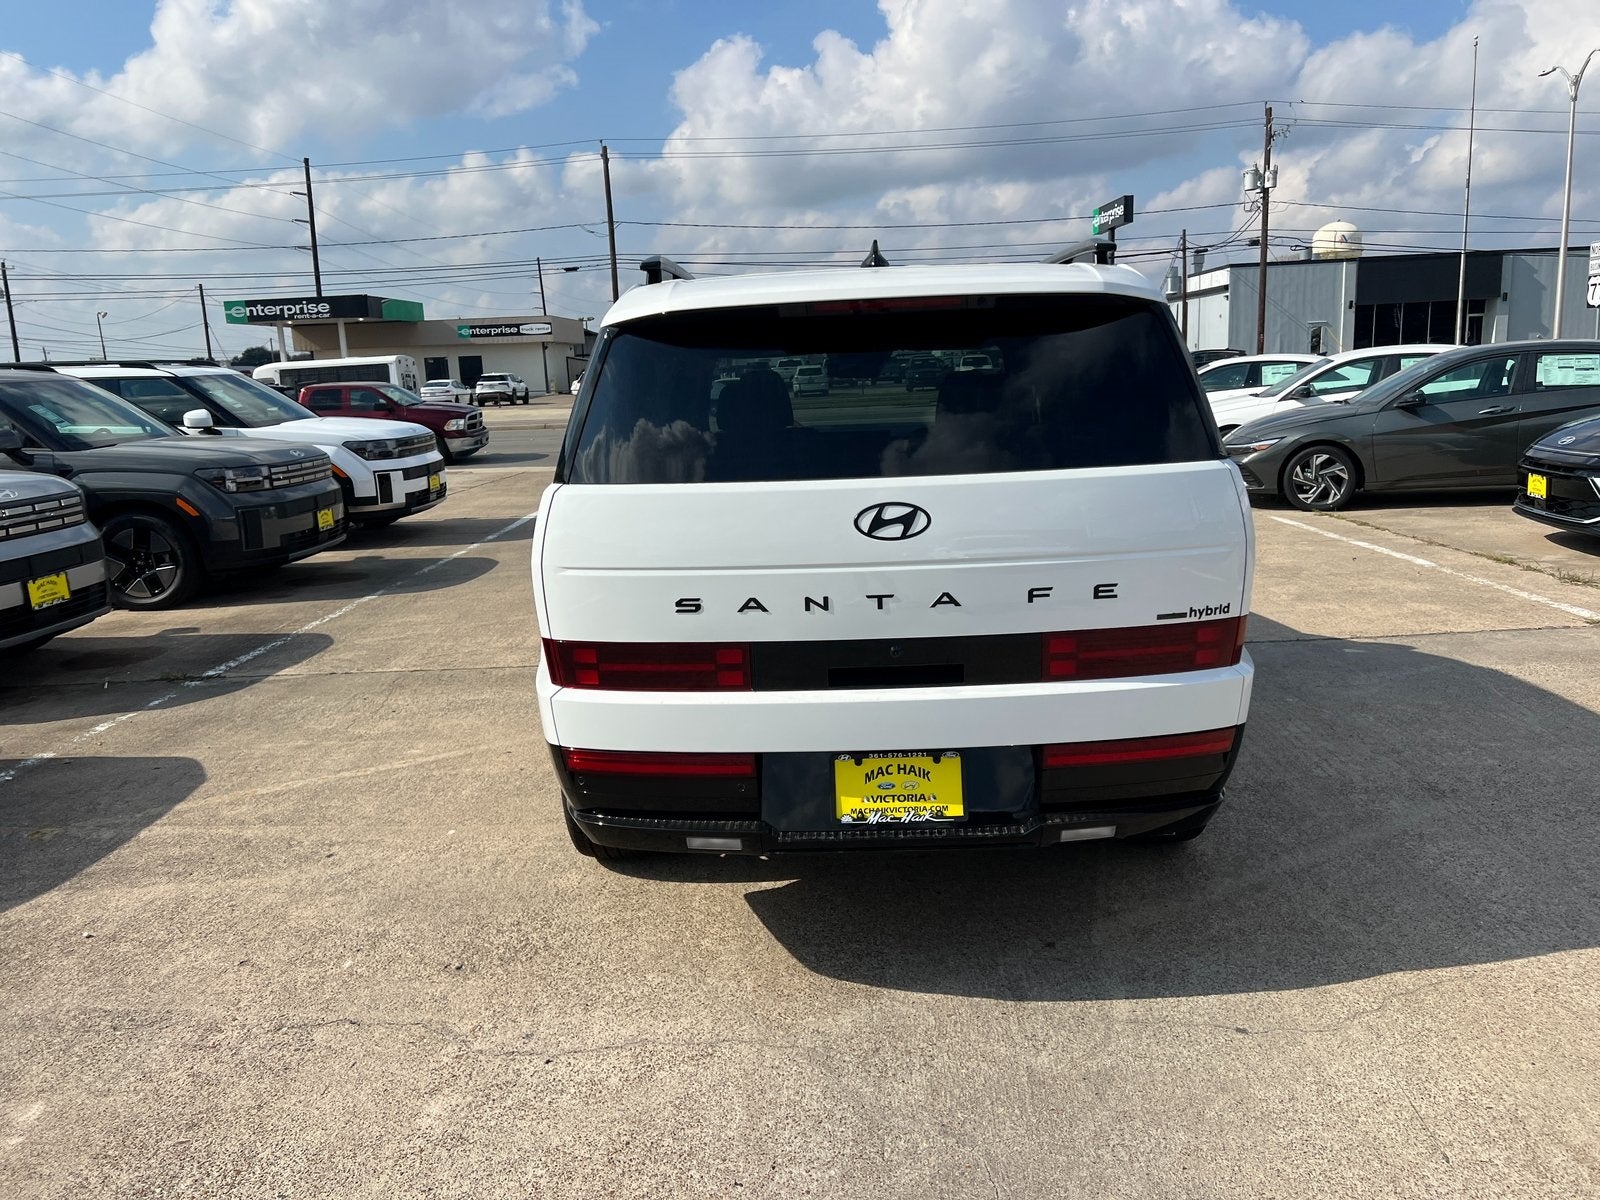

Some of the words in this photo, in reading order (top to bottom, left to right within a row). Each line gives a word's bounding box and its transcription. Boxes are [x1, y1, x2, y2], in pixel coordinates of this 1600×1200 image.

[1092, 204, 1124, 227] enterprise
[227, 301, 330, 318] enterprise
[459, 326, 518, 335] enterprise
[675, 592, 962, 613] SANTA
[1028, 583, 1118, 603] FE
[1189, 603, 1230, 619] hybrid
[864, 764, 893, 784] MAC
[897, 764, 931, 782] HAIK
[871, 794, 927, 803] VICTORIA
[865, 810, 899, 824] Mac
[900, 810, 936, 823] Haik
